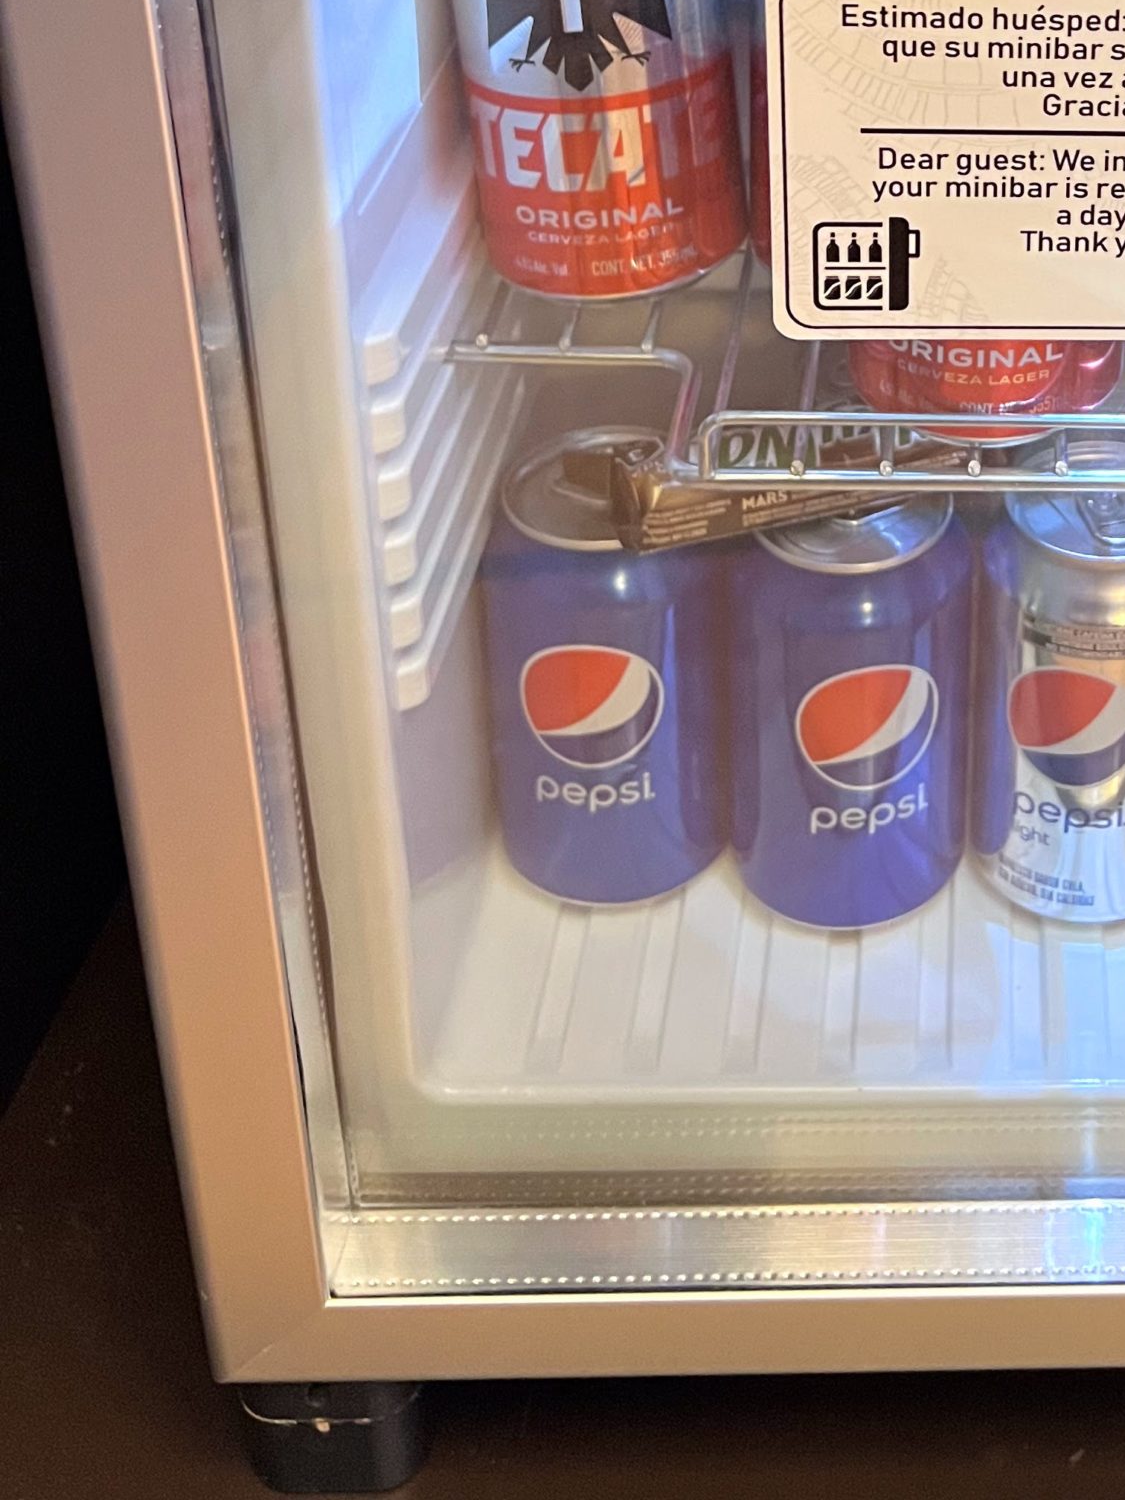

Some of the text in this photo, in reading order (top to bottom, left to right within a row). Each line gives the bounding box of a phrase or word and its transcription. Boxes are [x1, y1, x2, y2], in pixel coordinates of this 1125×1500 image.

[841, 3, 984, 29] Estimado
[882, 39, 936, 63] que
[944, 40, 979, 58] su
[988, 36, 1104, 60] minibar
[1002, 70, 1056, 87] una
[1063, 71, 1113, 88] vez
[878, 147, 949, 170] Dear
[956, 150, 1045, 176] guest:
[1052, 149, 1095, 171] We
[872, 180, 938, 203] your
[945, 176, 1058, 198] minibar
[1065, 177, 1089, 199] is
[516, 198, 684, 229] ORIGINAL
[1056, 209, 1071, 225] a
[528, 231, 609, 245] CERVEZA
[1020, 230, 1108, 252] Thank
[889, 340, 1064, 368] ORIGINAL
[897, 358, 1050, 385] CERVEZA LAGER
[741, 489, 789, 512] MARS
[536, 772, 653, 813] pepsi
[810, 783, 929, 835] pepsi
[1012, 791, 1124, 834] pepsi
[1018, 825, 1051, 846] ght
